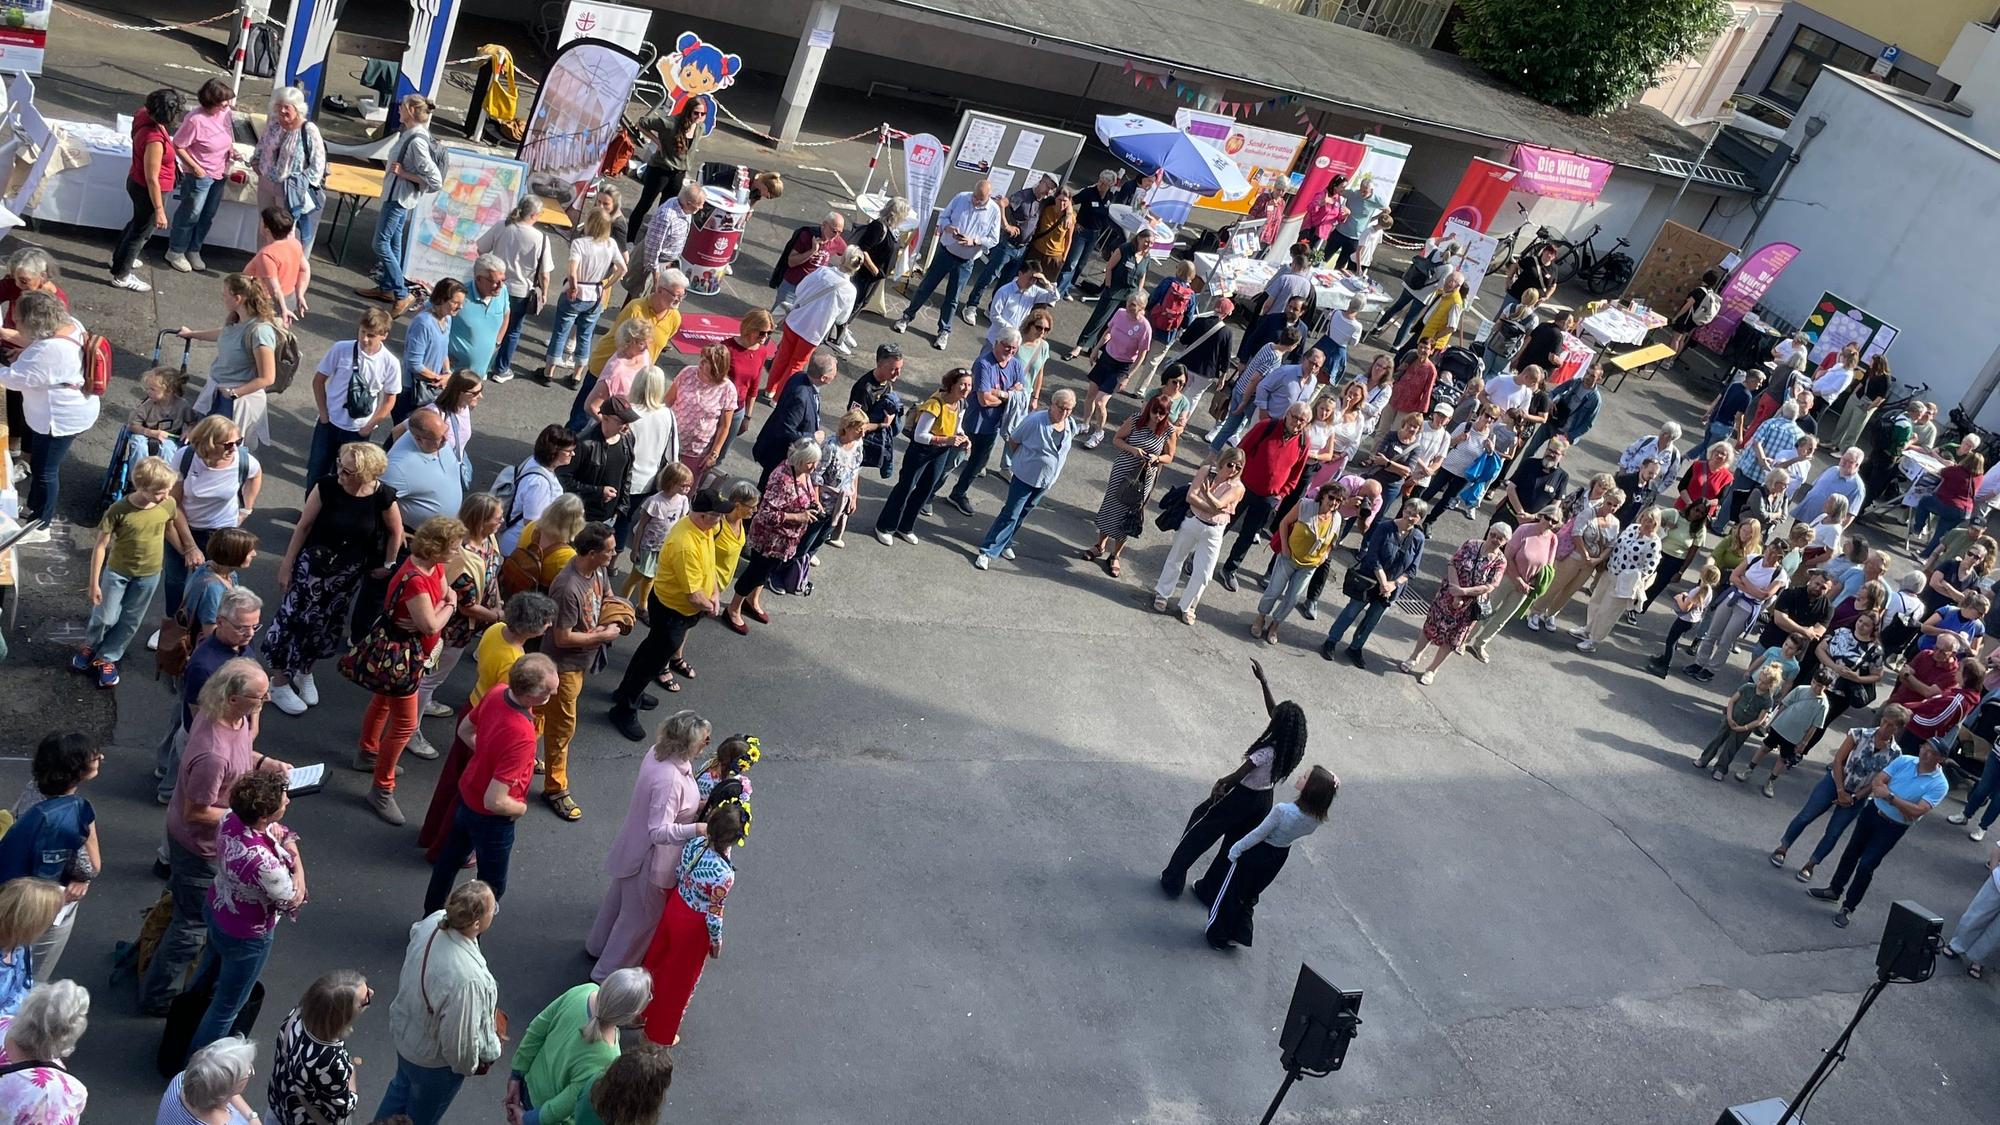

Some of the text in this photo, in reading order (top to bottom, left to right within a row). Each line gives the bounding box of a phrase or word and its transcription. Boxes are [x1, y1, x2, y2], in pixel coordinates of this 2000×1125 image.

[1883, 46, 1897, 58] P
[1538, 156, 1590, 179] Die Würde
